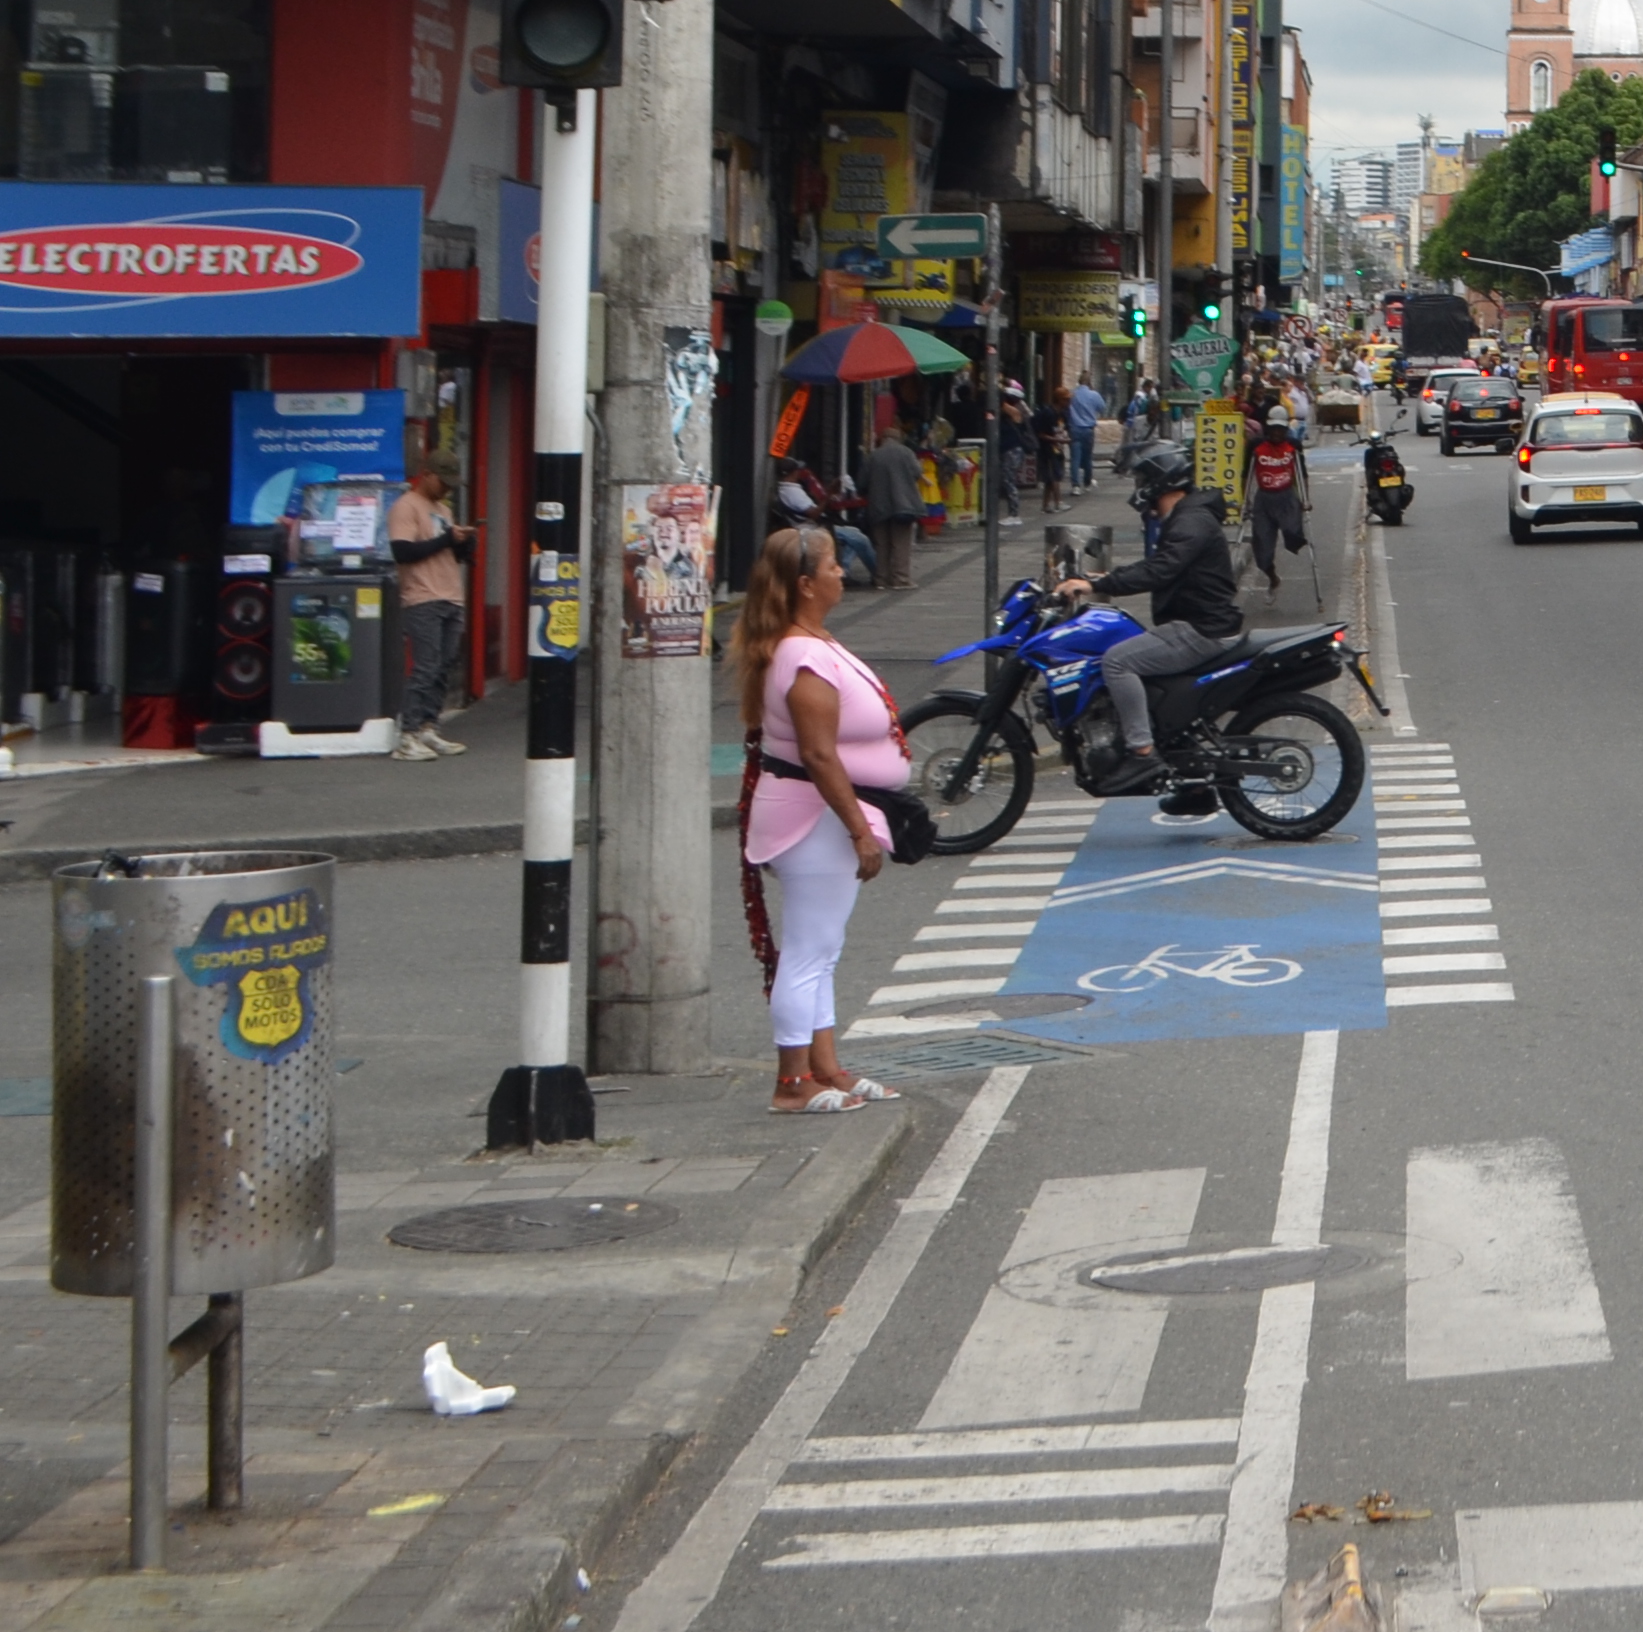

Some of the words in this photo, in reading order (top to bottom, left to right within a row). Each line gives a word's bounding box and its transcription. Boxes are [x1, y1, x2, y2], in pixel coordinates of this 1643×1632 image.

[1282, 133, 1302, 250] HOTEL
[0, 241, 320, 275] ELECTROFERTAS
[1223, 423, 1237, 495] MOTOS
[1259, 454, 1290, 465] Claro
[194, 948, 264, 969] SOMOS
[255, 974, 289, 991] CDA
[252, 993, 292, 1012] SOLO
[245, 1009, 297, 1029] MOTOS
